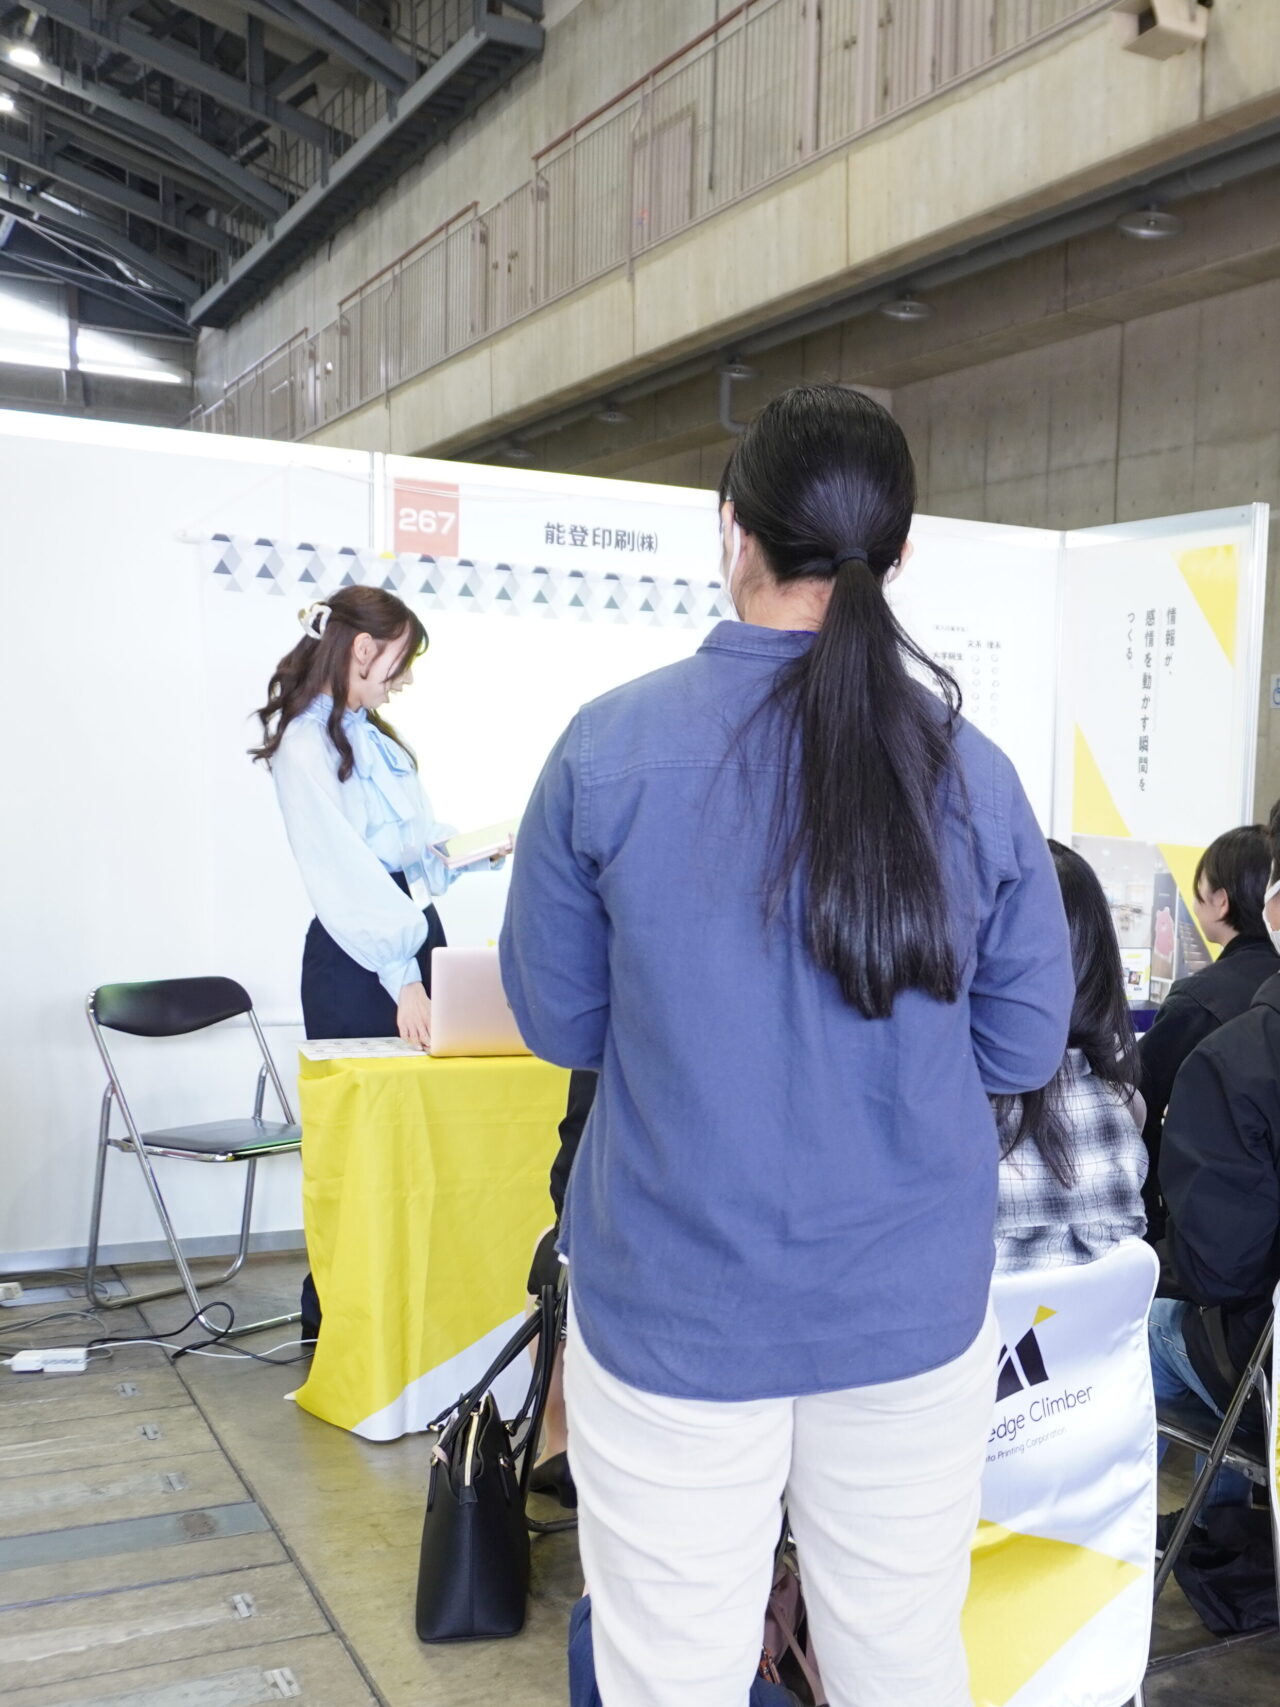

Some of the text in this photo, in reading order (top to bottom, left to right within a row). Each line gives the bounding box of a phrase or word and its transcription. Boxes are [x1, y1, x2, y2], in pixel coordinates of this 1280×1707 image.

[399, 507, 456, 534] 267
[1030, 1386, 1092, 1422] Climber
[997, 1444, 1025, 1460] Printing
[1026, 1427, 1066, 1448] Corporation
